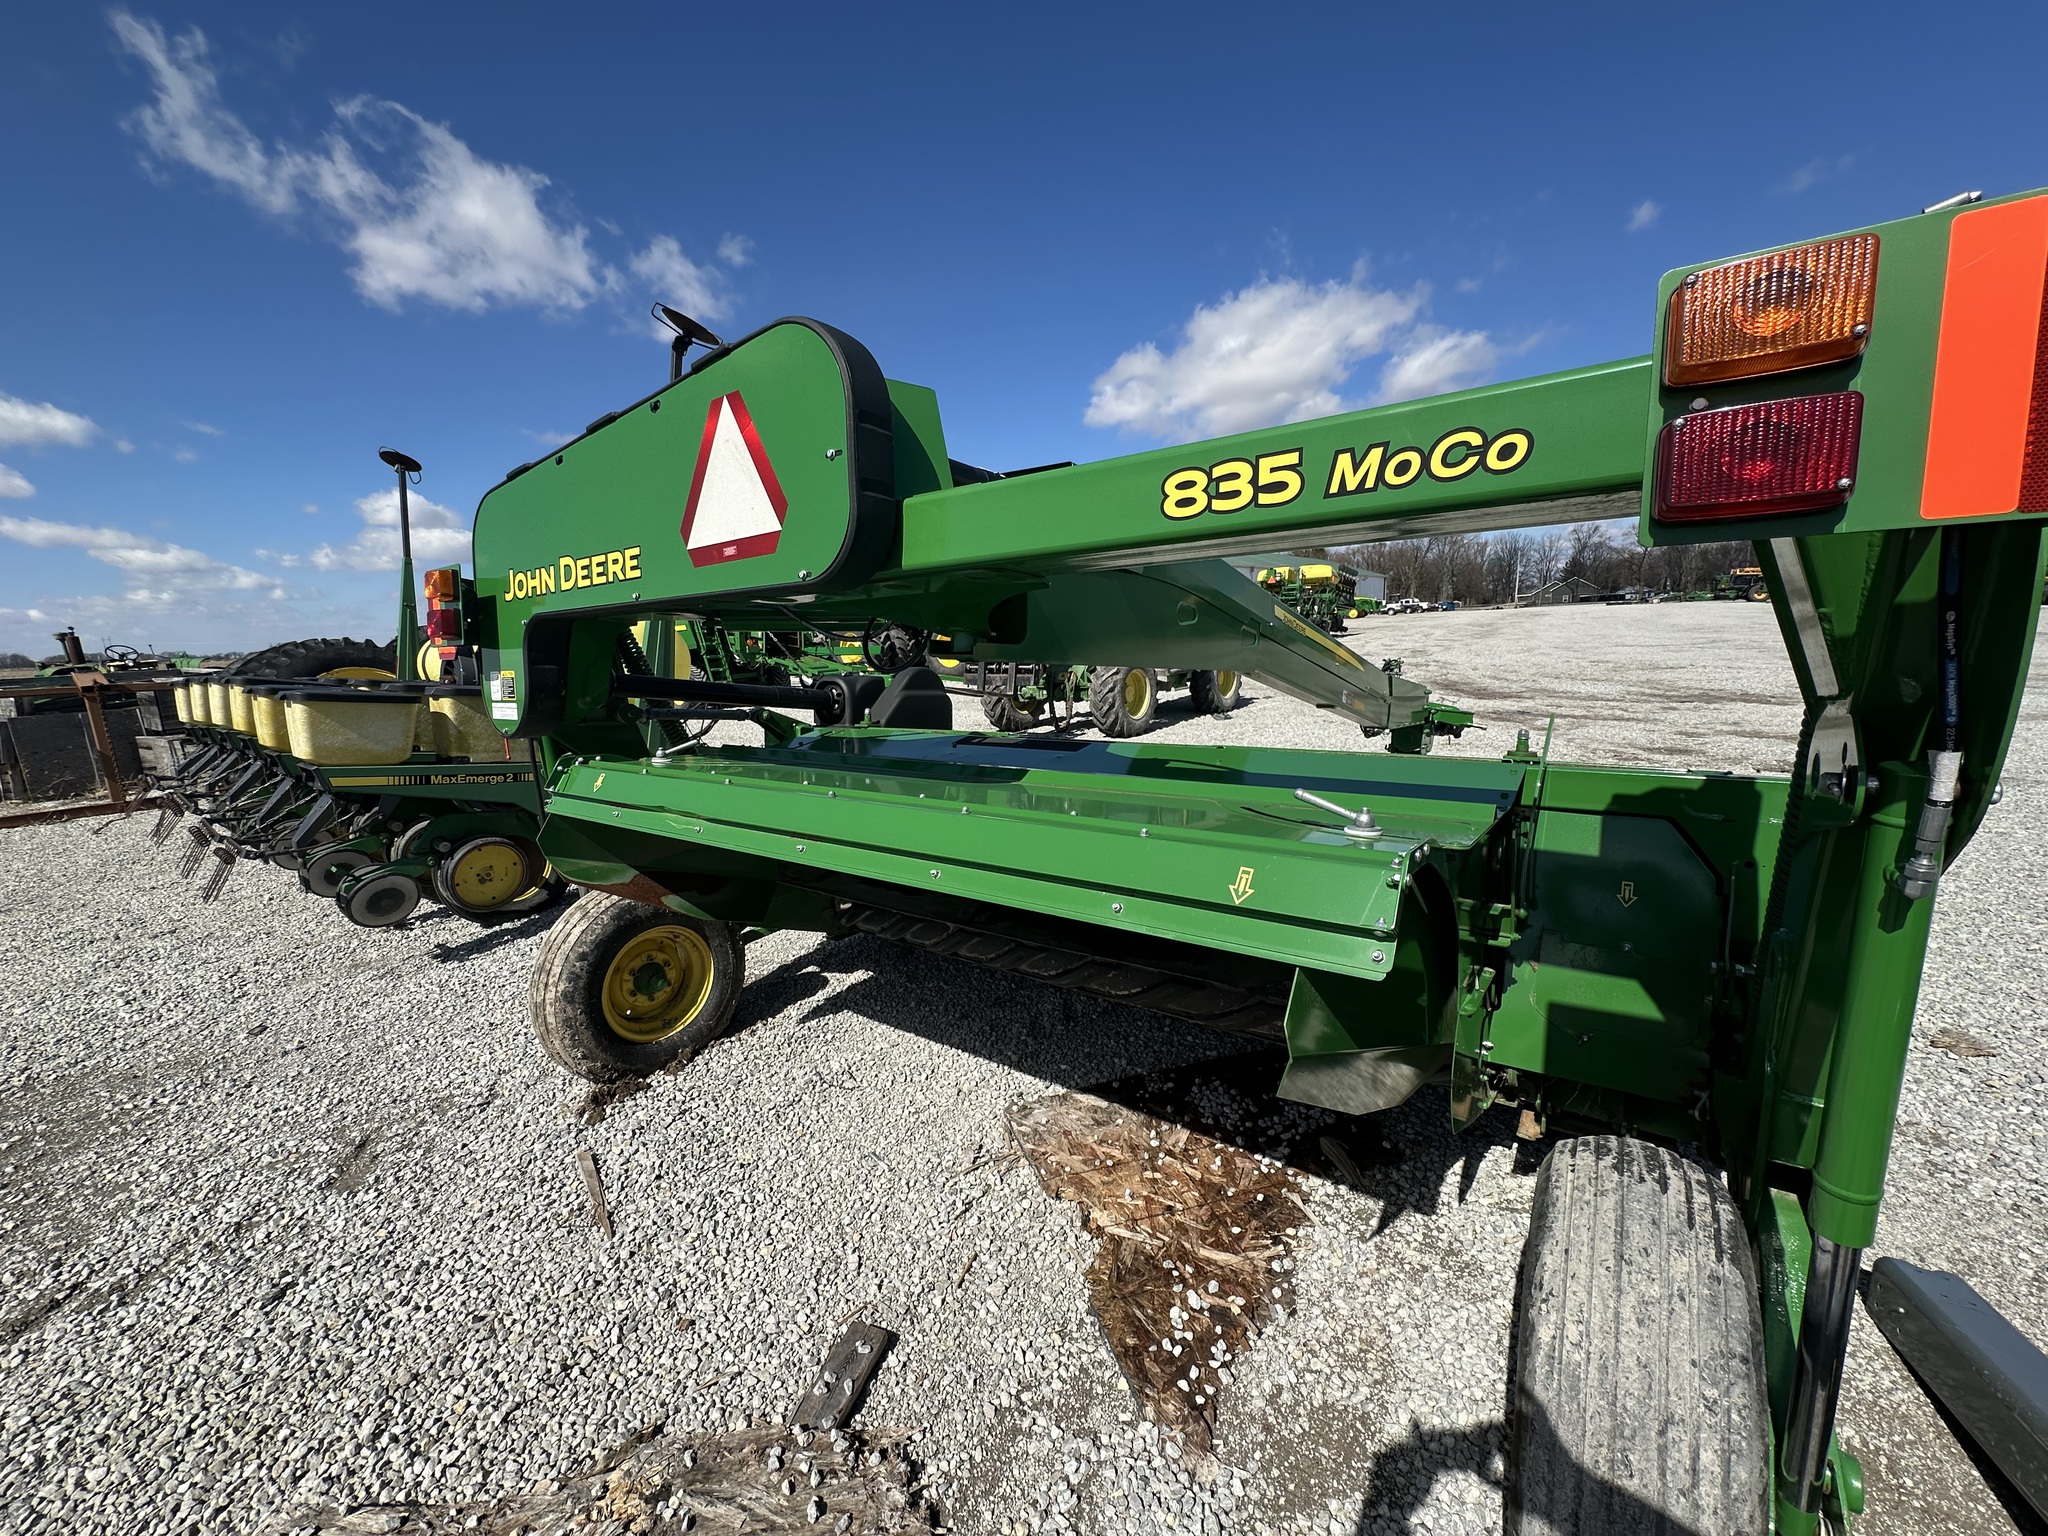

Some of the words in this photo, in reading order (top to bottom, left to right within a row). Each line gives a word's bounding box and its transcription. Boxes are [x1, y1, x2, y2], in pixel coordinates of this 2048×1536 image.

[1161, 447, 1303, 521] 835
[1324, 426, 1534, 499] MoCo
[504, 565, 555, 602] JOHN
[559, 546, 642, 592] DEERE
[430, 774, 504, 784] MaxEmerge
[506, 773, 514, 783] 2
